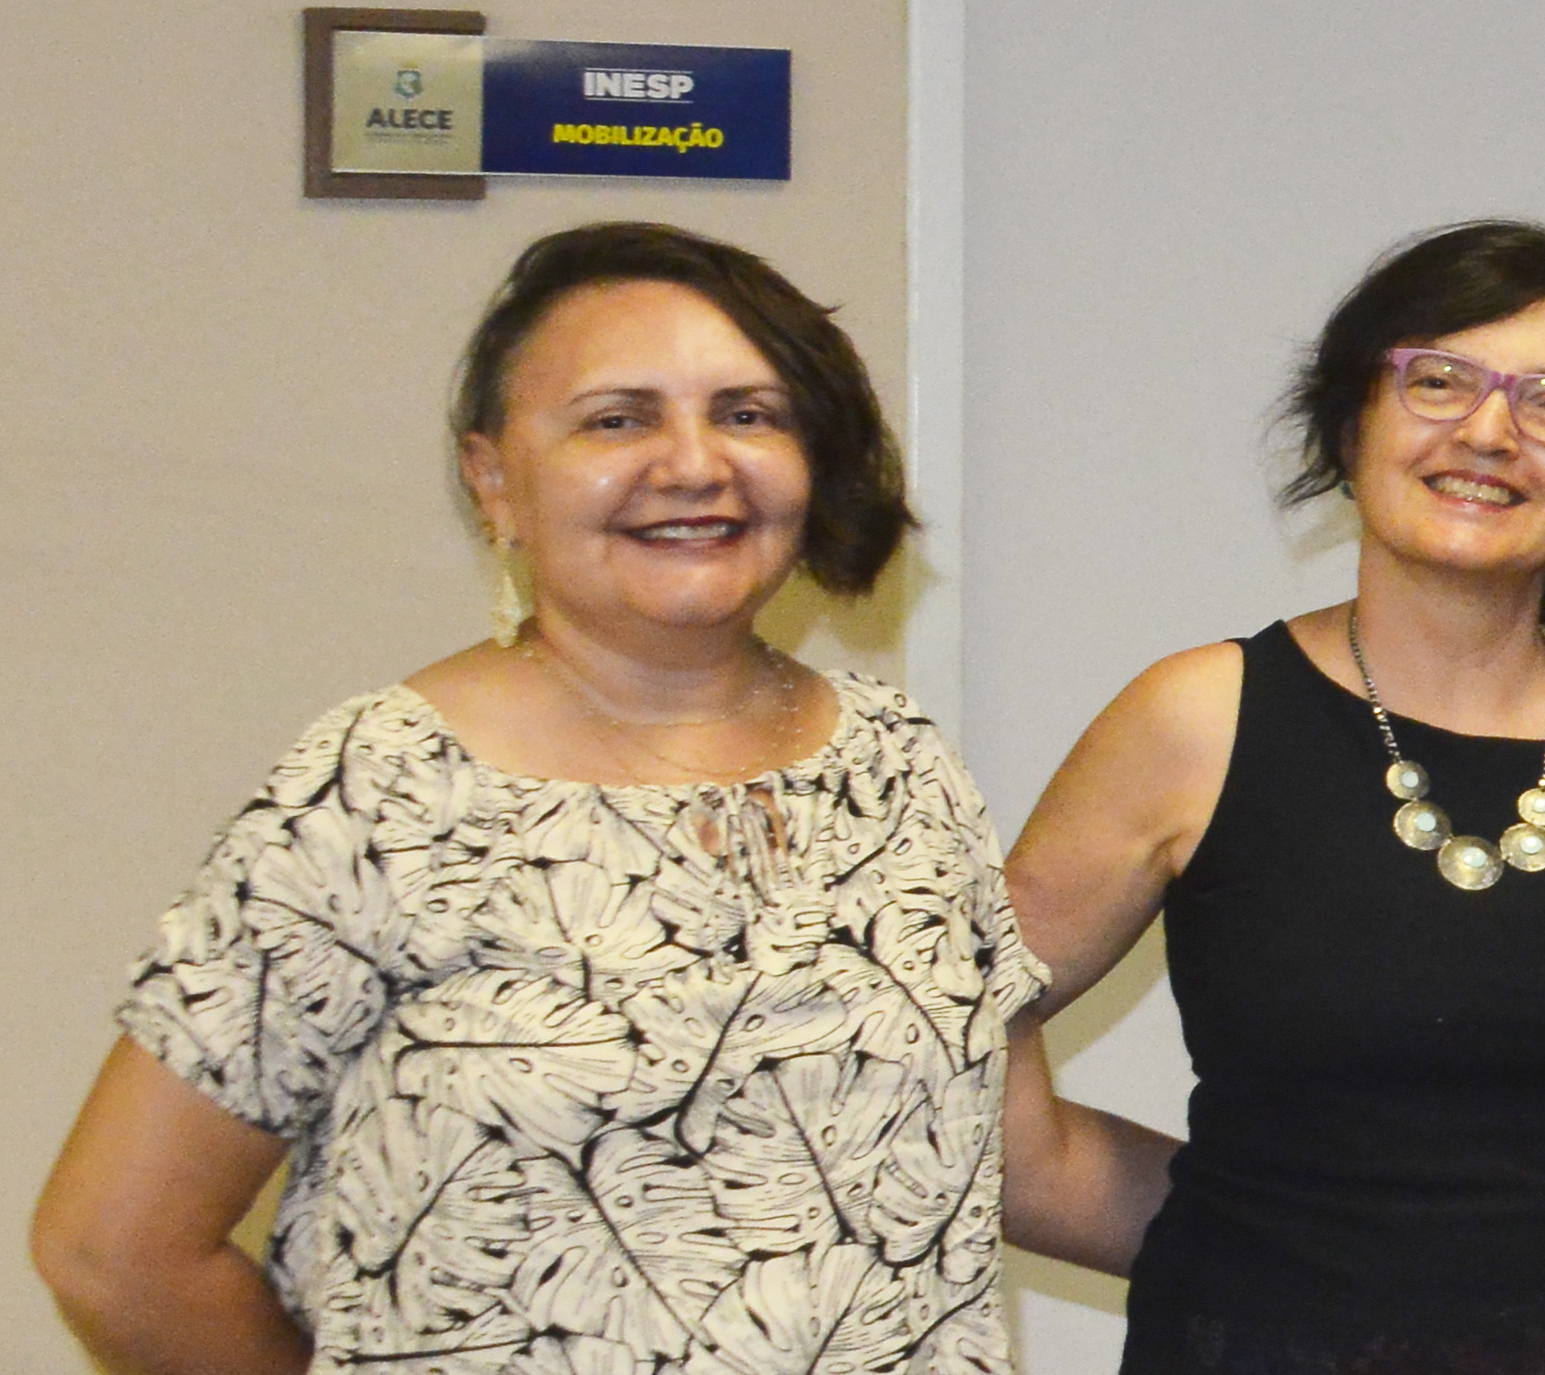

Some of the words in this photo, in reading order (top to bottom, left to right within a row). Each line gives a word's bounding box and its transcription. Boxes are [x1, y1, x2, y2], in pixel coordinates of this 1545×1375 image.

[584, 71, 694, 99] INESP
[365, 109, 454, 130] ALECE
[553, 123, 723, 153] MOBILIZAÇÃO
